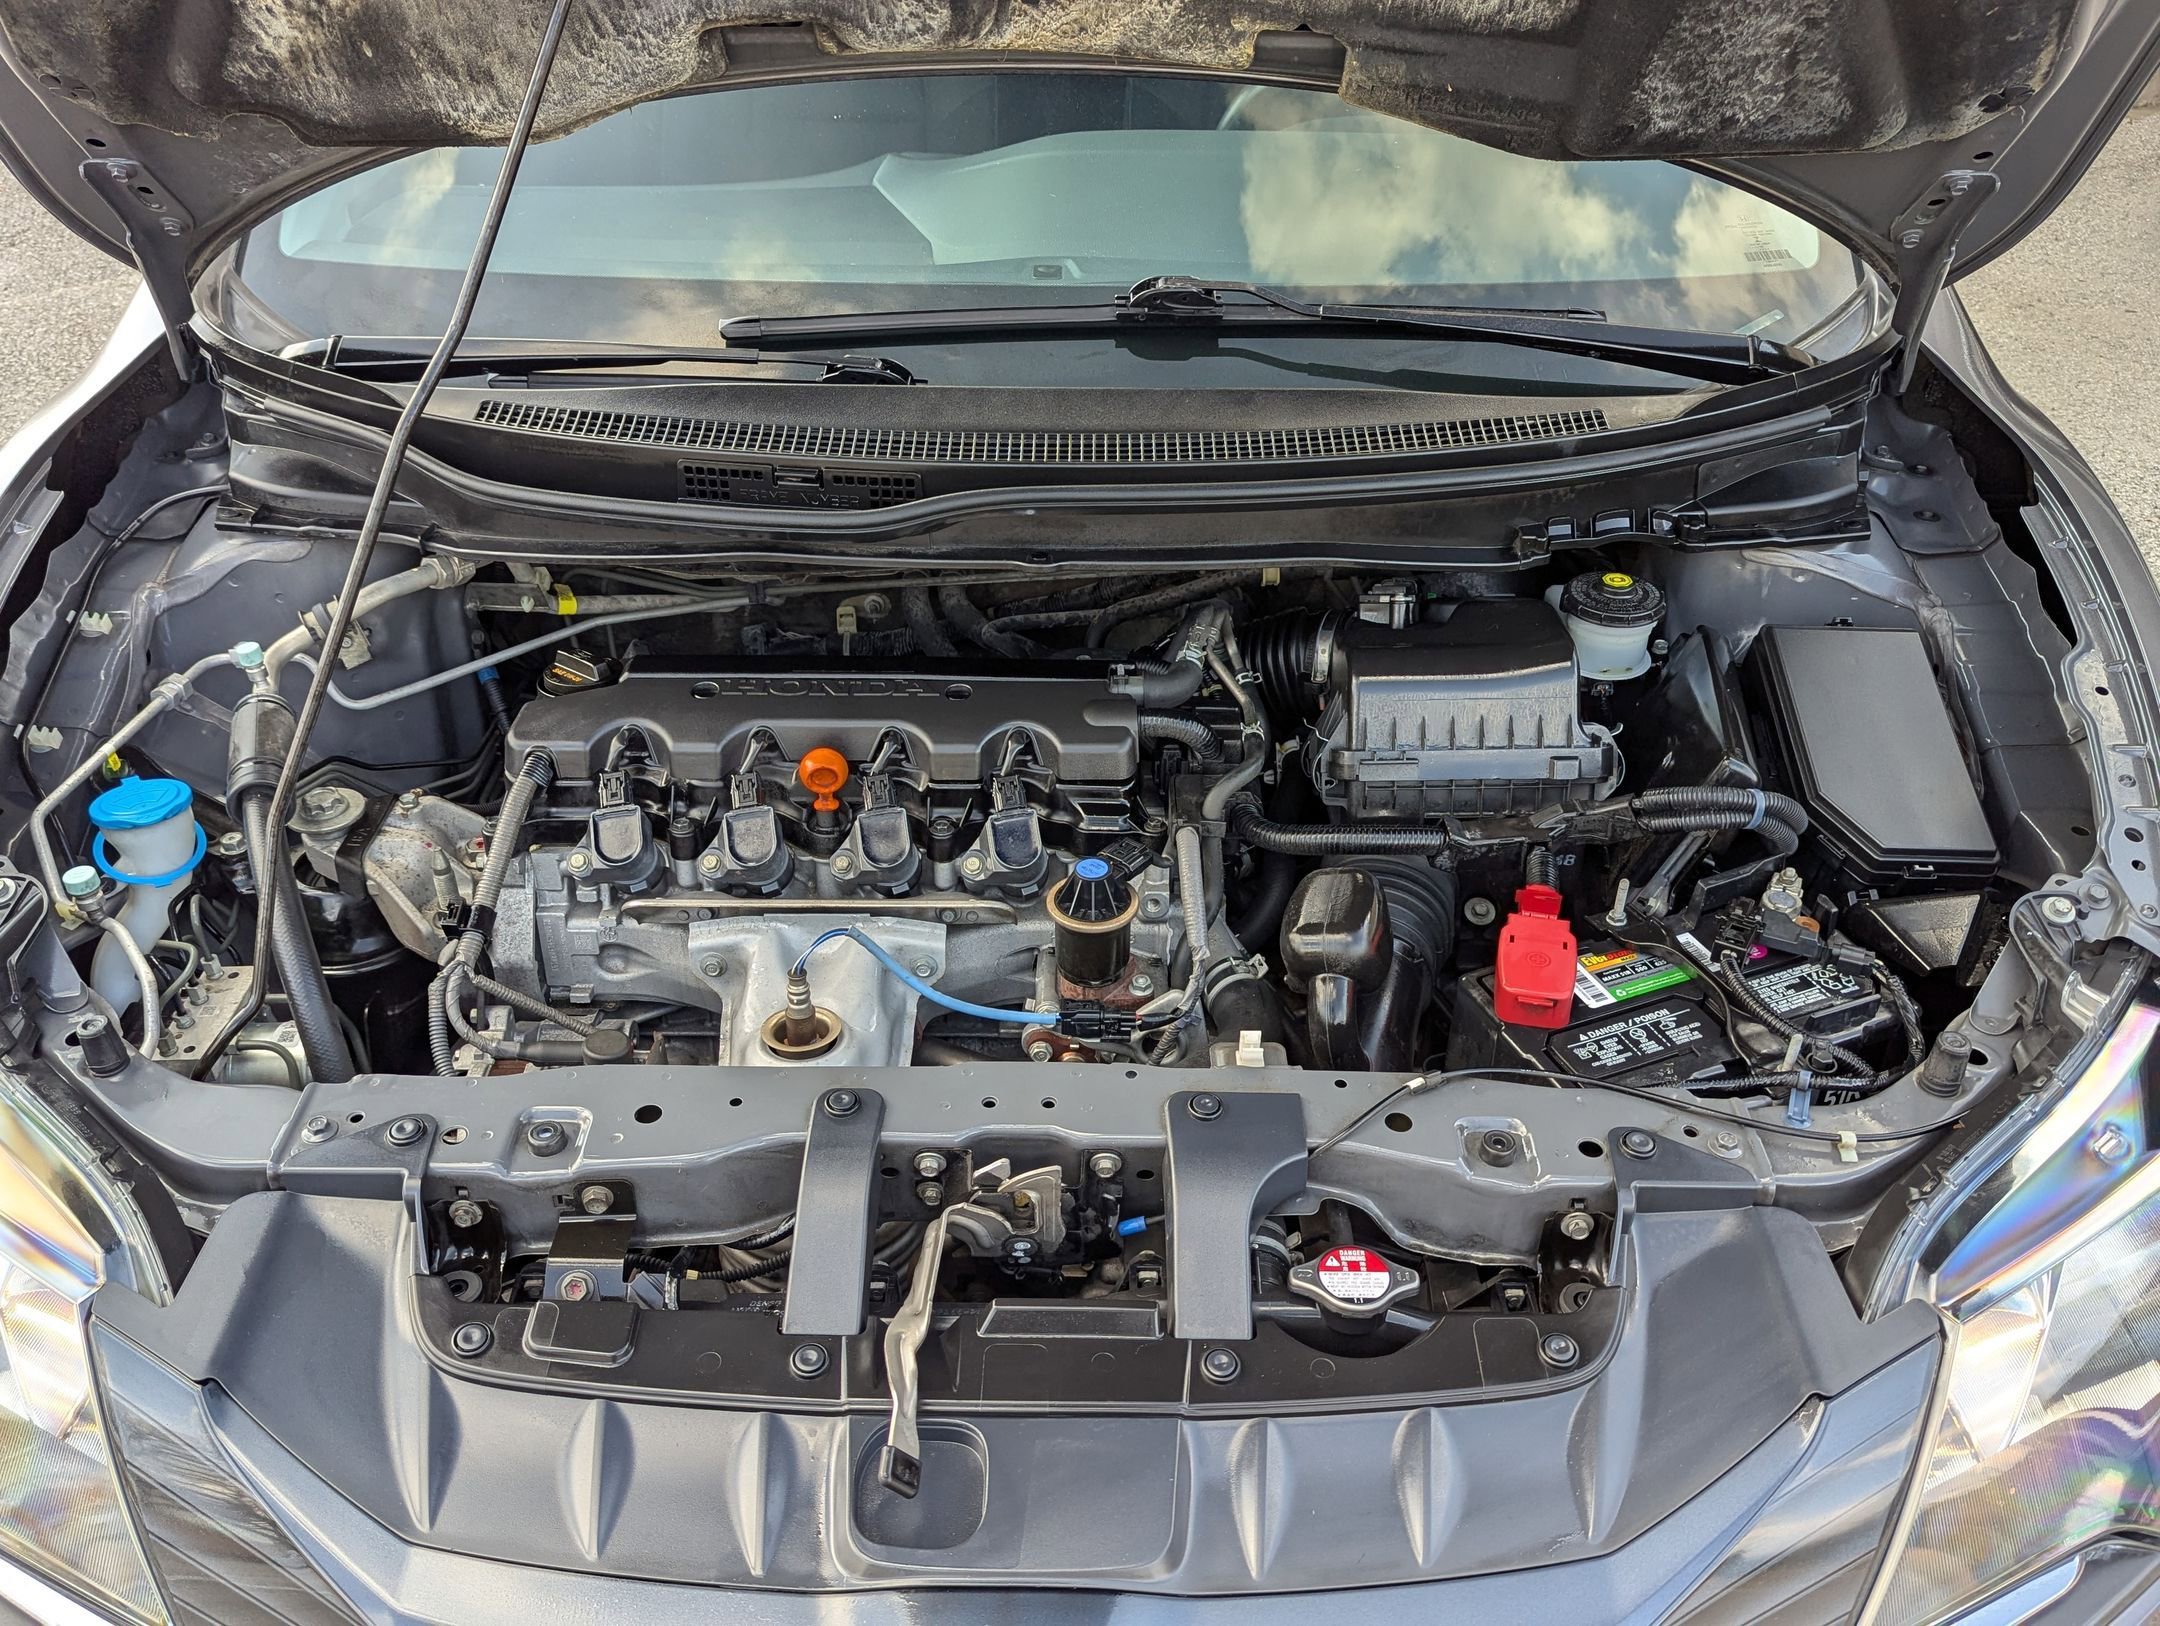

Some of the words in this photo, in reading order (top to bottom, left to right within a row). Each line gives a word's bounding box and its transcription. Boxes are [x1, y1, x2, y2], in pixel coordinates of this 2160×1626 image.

[739, 488, 788, 503] FRAME
[800, 491, 860, 509] NUMBER
[721, 679, 940, 697] HONDA
[1586, 1022, 1629, 1039] DANGER
[1633, 1008, 1671, 1024] POISON
